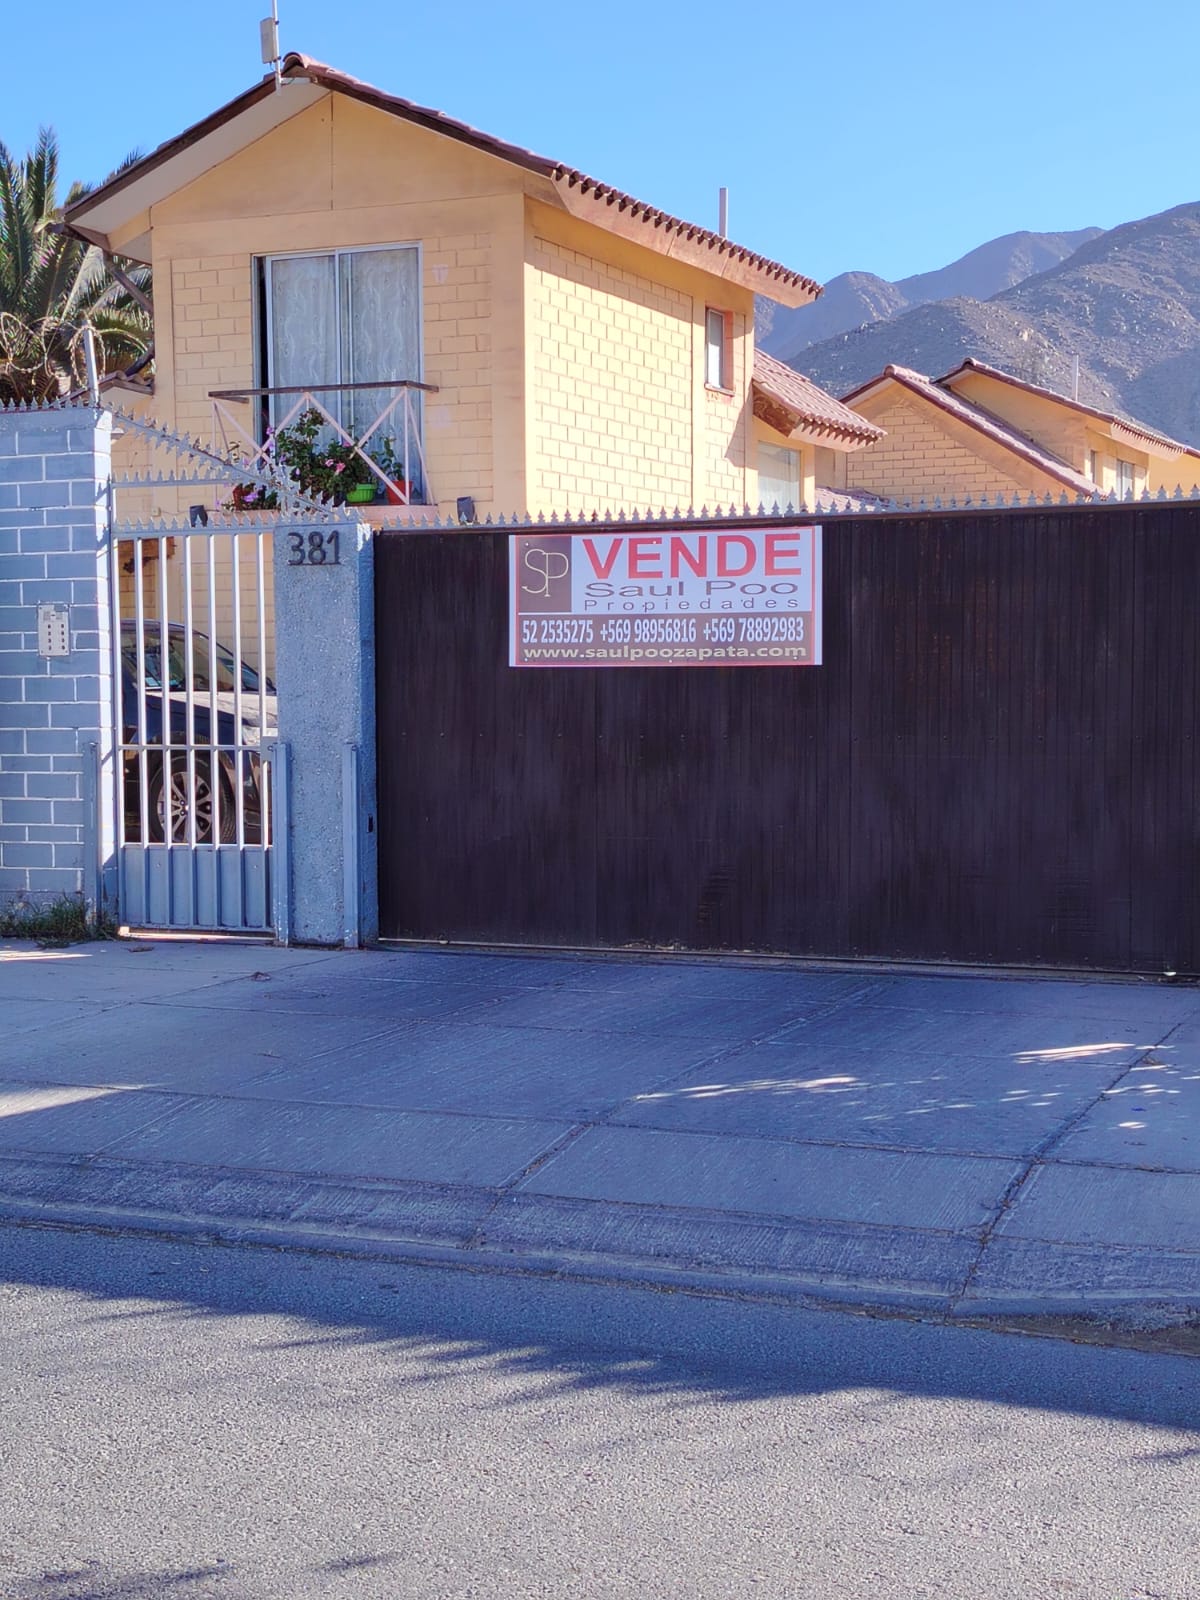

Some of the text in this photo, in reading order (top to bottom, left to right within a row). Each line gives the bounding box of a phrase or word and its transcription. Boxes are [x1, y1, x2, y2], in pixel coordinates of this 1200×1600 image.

[287, 530, 340, 566] 381
[582, 533, 802, 580] VENDE
[585, 580, 798, 598] Saul Poo
[584, 597, 799, 613] Propiedades
[522, 616, 804, 643] 52 2535275 +569 98956816 +569 78892983
[524, 645, 807, 661] www.saulpoozapata.com
